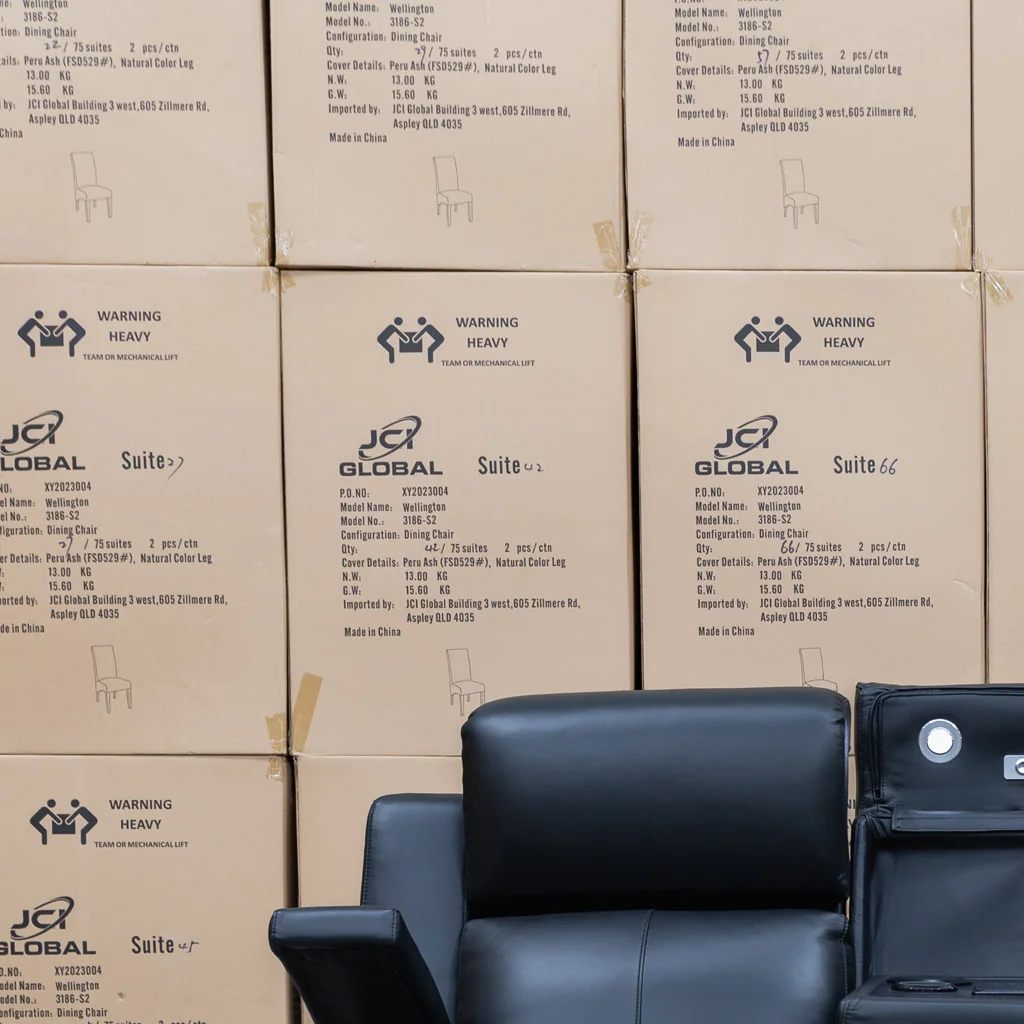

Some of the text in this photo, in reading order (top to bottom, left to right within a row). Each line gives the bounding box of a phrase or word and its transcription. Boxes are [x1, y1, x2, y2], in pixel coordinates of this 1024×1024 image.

[389, 3, 435, 16] Wellington
[737, 7, 782, 19] Wellington
[738, 20, 773, 32] 3186-S2
[739, 35, 790, 48] Dining Chair
[26, 69, 71, 81] 13.00 KG
[392, 103, 405, 115] JCI
[406, 103, 434, 115] Global
[435, 104, 471, 117] Building
[472, 104, 478, 116] 3
[520, 105, 556, 117] Zillmere
[28, 113, 100, 126] Aspley QLD 4035
[329, 132, 388, 143] Made in China
[677, 136, 735, 148] Made in China
[96, 310, 162, 322] WARNING
[455, 316, 519, 328] WARNING
[812, 316, 876, 328] WARNING
[109, 331, 151, 342] HEAVY
[823, 336, 865, 348] HEAVY
[467, 337, 509, 349] HEAVY
[83, 353, 104, 361] TEAM
[104, 353, 116, 361] OR
[116, 353, 164, 361] MECHANICAL
[441, 359, 535, 367] TEAM OR MECHANICAL LIFT
[797, 359, 891, 367] TEAM OR MECHANICAL LIFT
[0, 423, 56, 445] JCI
[359, 429, 414, 450] JCI
[715, 428, 770, 449] JCI
[121, 450, 165, 471] Suite
[477, 455, 521, 475] Suite
[833, 455, 898, 475] Suite 66
[338, 459, 444, 477] GLOBAL
[694, 458, 799, 476] GLOBAL
[44, 481, 92, 492] XY2023004
[401, 486, 449, 497] XY2023004
[757, 485, 804, 496] XY2023004
[44, 497, 90, 510] Wellington
[340, 501, 365, 513] Model
[402, 501, 447, 514] Wellington
[403, 529, 431, 542] Dining
[432, 528, 455, 540] Chair
[696, 556, 720, 568] Cover
[757, 556, 776, 567] Peru
[777, 556, 793, 567] Ash
[849, 555, 881, 567] Natural
[881, 555, 904, 566] Color
[905, 555, 920, 568] Leg
[50, 608, 120, 621] Aspley QLD 4035
[344, 626, 402, 637] Made in China
[108, 799, 173, 810] WARNING
[120, 819, 162, 830] HEAVY
[11, 909, 67, 930] JCI
[131, 935, 175, 955] Suite
[54, 965, 102, 976] XY2023004
[54, 980, 100, 993] Wellington
